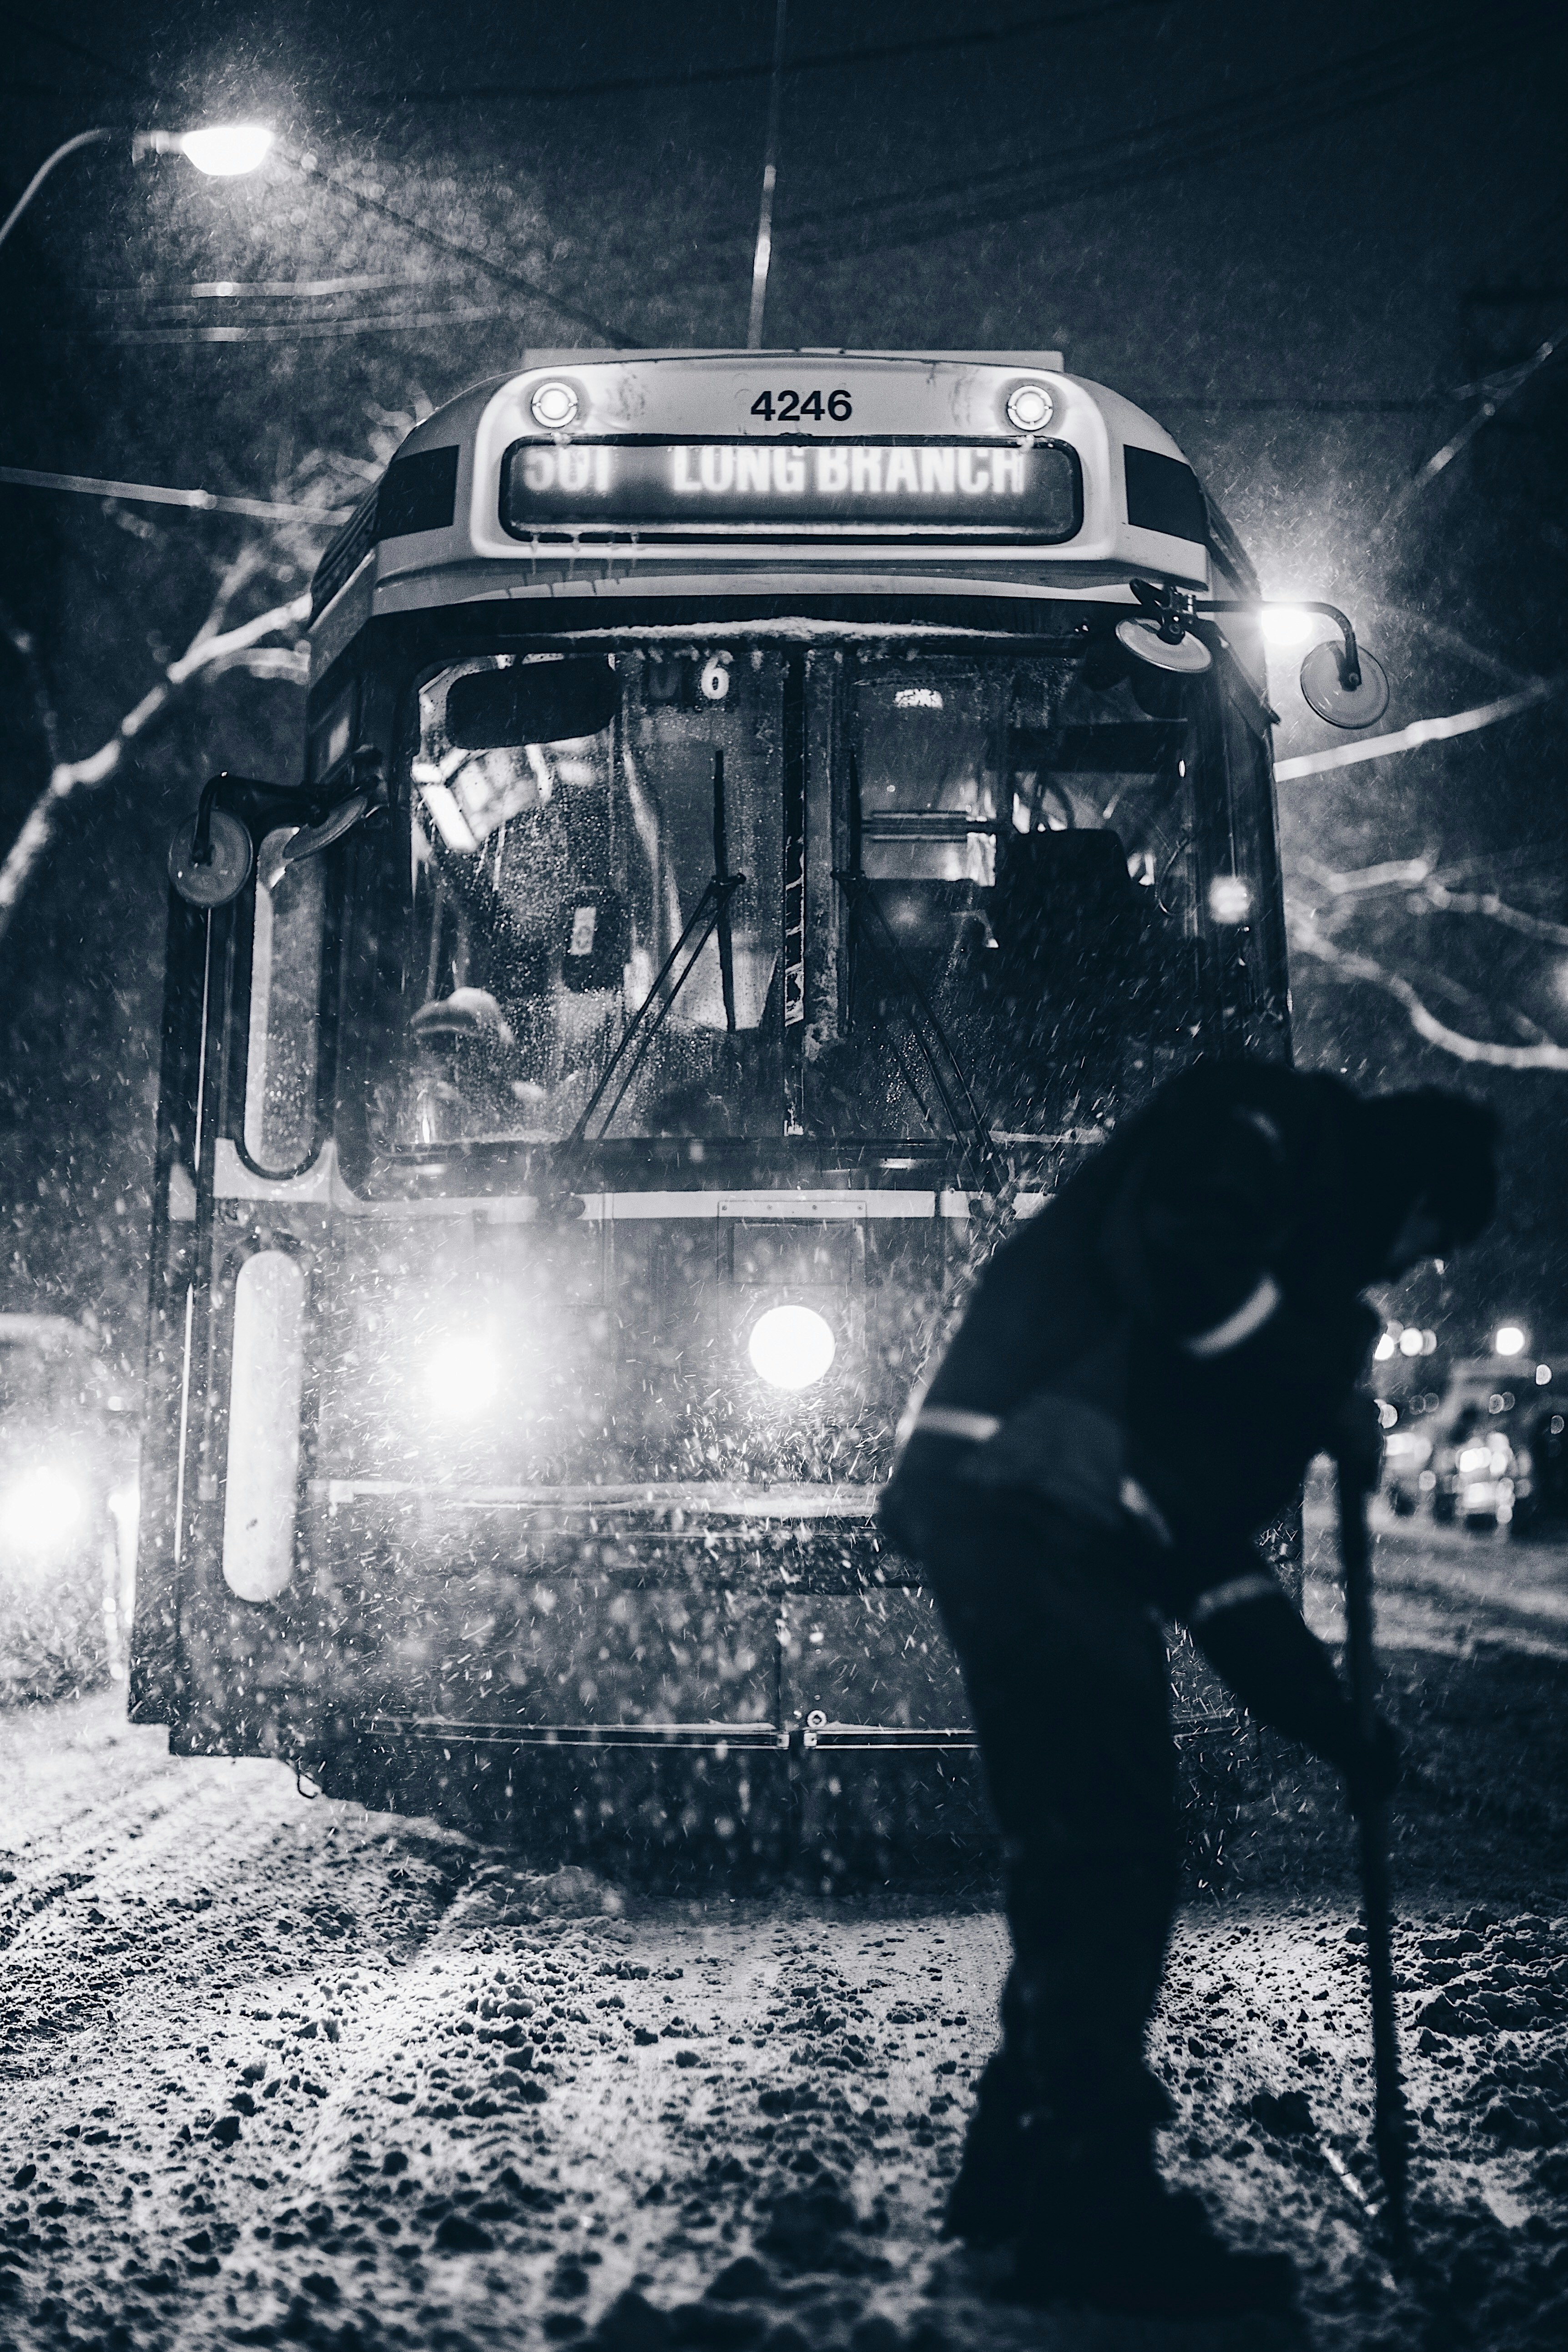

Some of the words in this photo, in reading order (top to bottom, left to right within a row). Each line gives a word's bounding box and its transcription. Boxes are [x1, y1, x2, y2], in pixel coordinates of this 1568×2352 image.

[751, 389, 852, 421] 4246
[673, 446, 805, 492] LONG
[817, 447, 1024, 493] BRANCH
